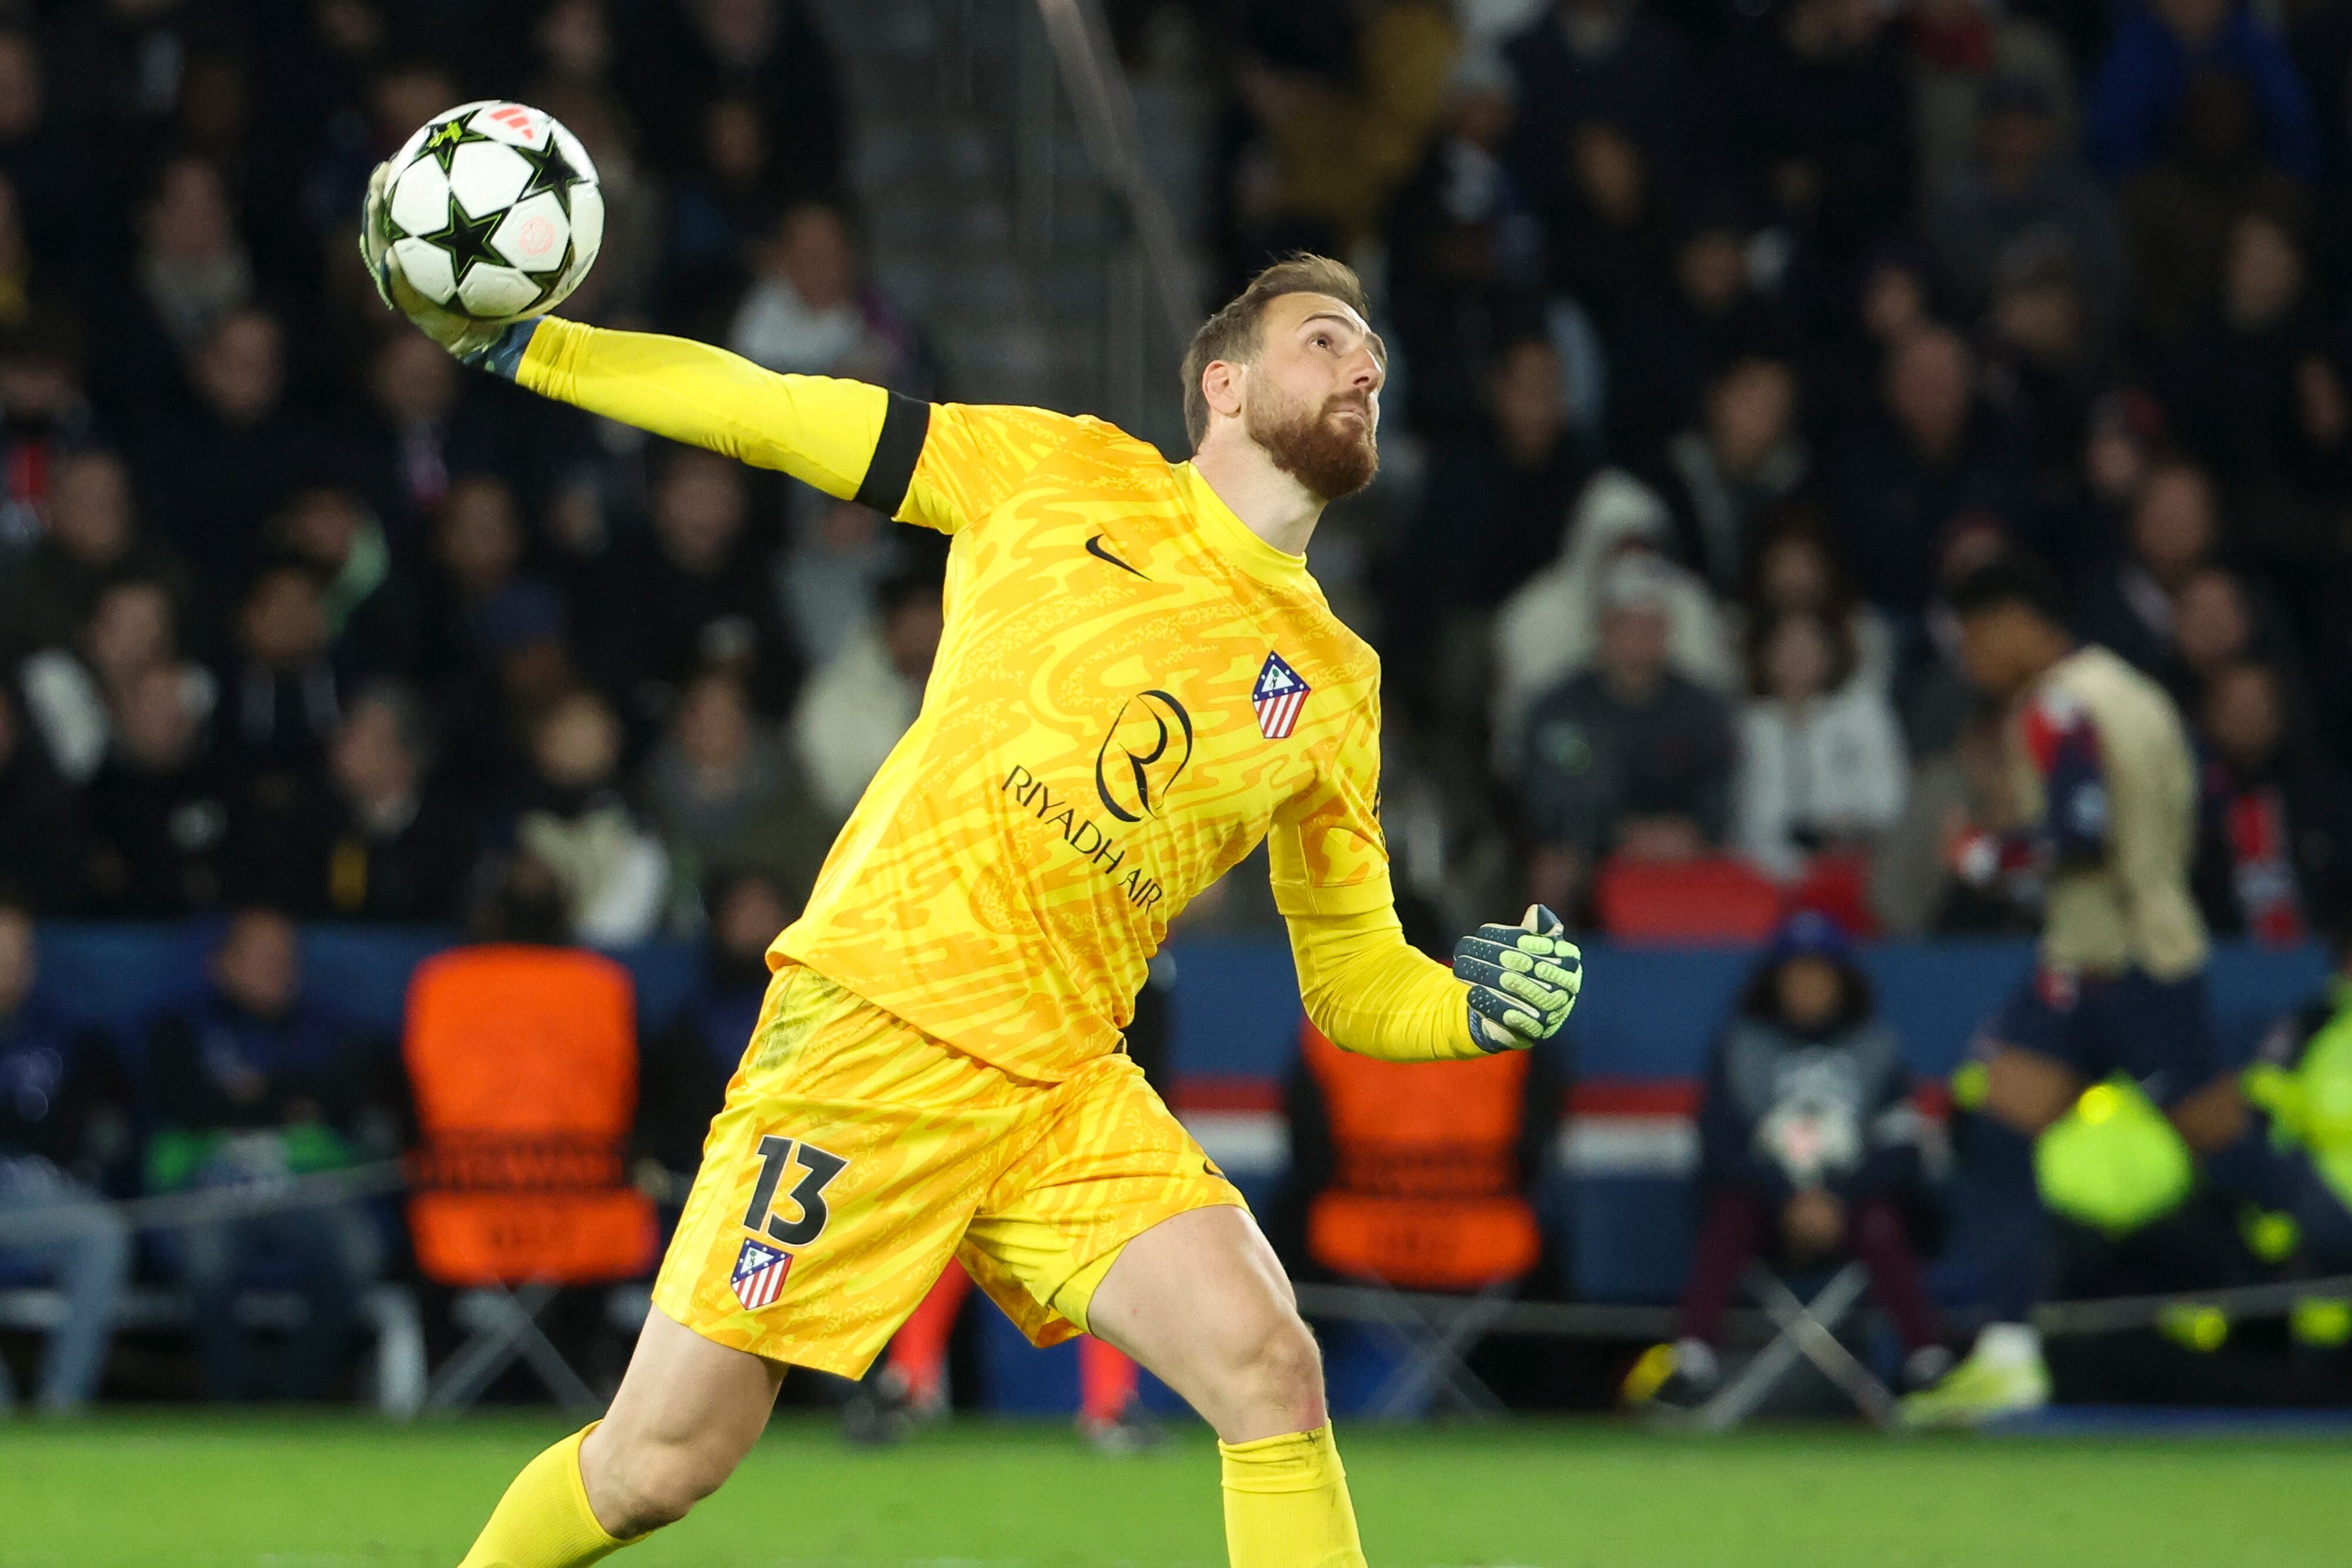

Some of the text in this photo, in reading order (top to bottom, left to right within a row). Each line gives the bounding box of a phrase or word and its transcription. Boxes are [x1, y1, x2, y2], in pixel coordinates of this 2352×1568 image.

[1002, 765, 1162, 914] RIYADH AIR
[743, 1135, 848, 1245] 13
